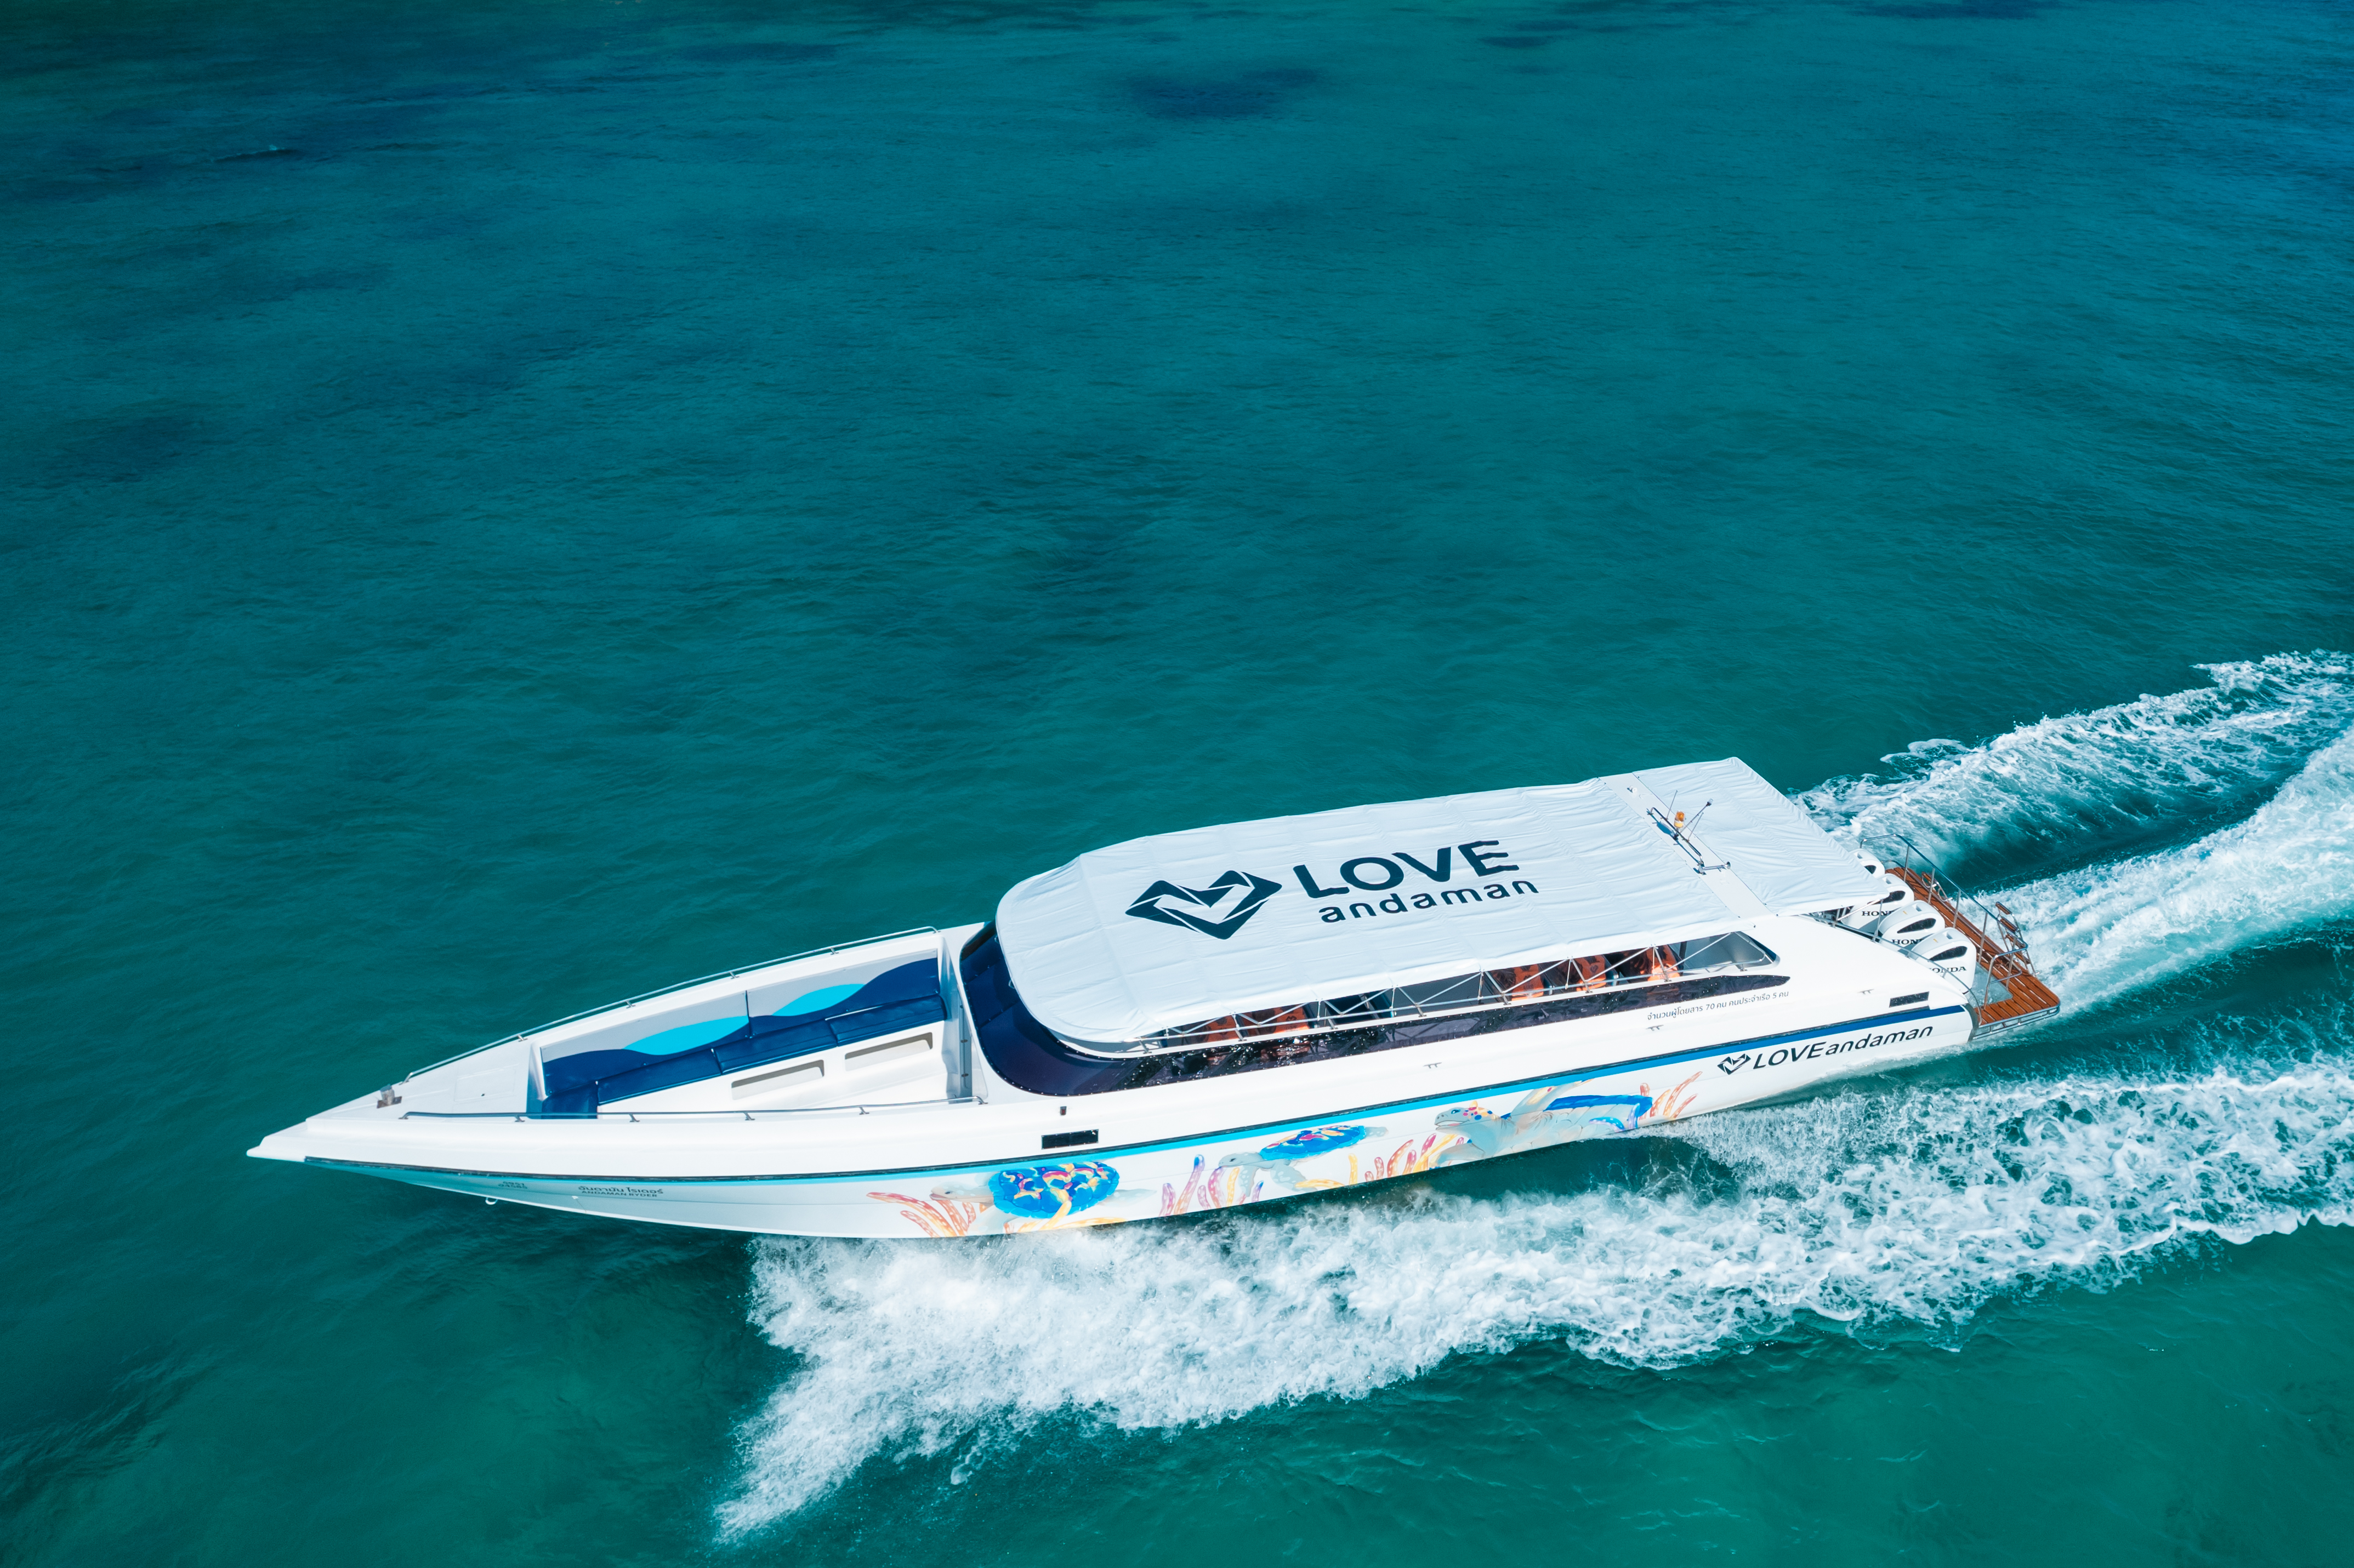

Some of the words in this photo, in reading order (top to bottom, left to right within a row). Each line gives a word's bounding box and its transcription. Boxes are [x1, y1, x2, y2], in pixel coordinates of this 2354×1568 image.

[1293, 840, 1520, 899] LOVE
[1318, 880, 1539, 923] andaman
[1647, 1006, 1703, 1020] จำนวนผู้โดยสาร
[1728, 993, 1770, 1007] คนประจำเรือ
